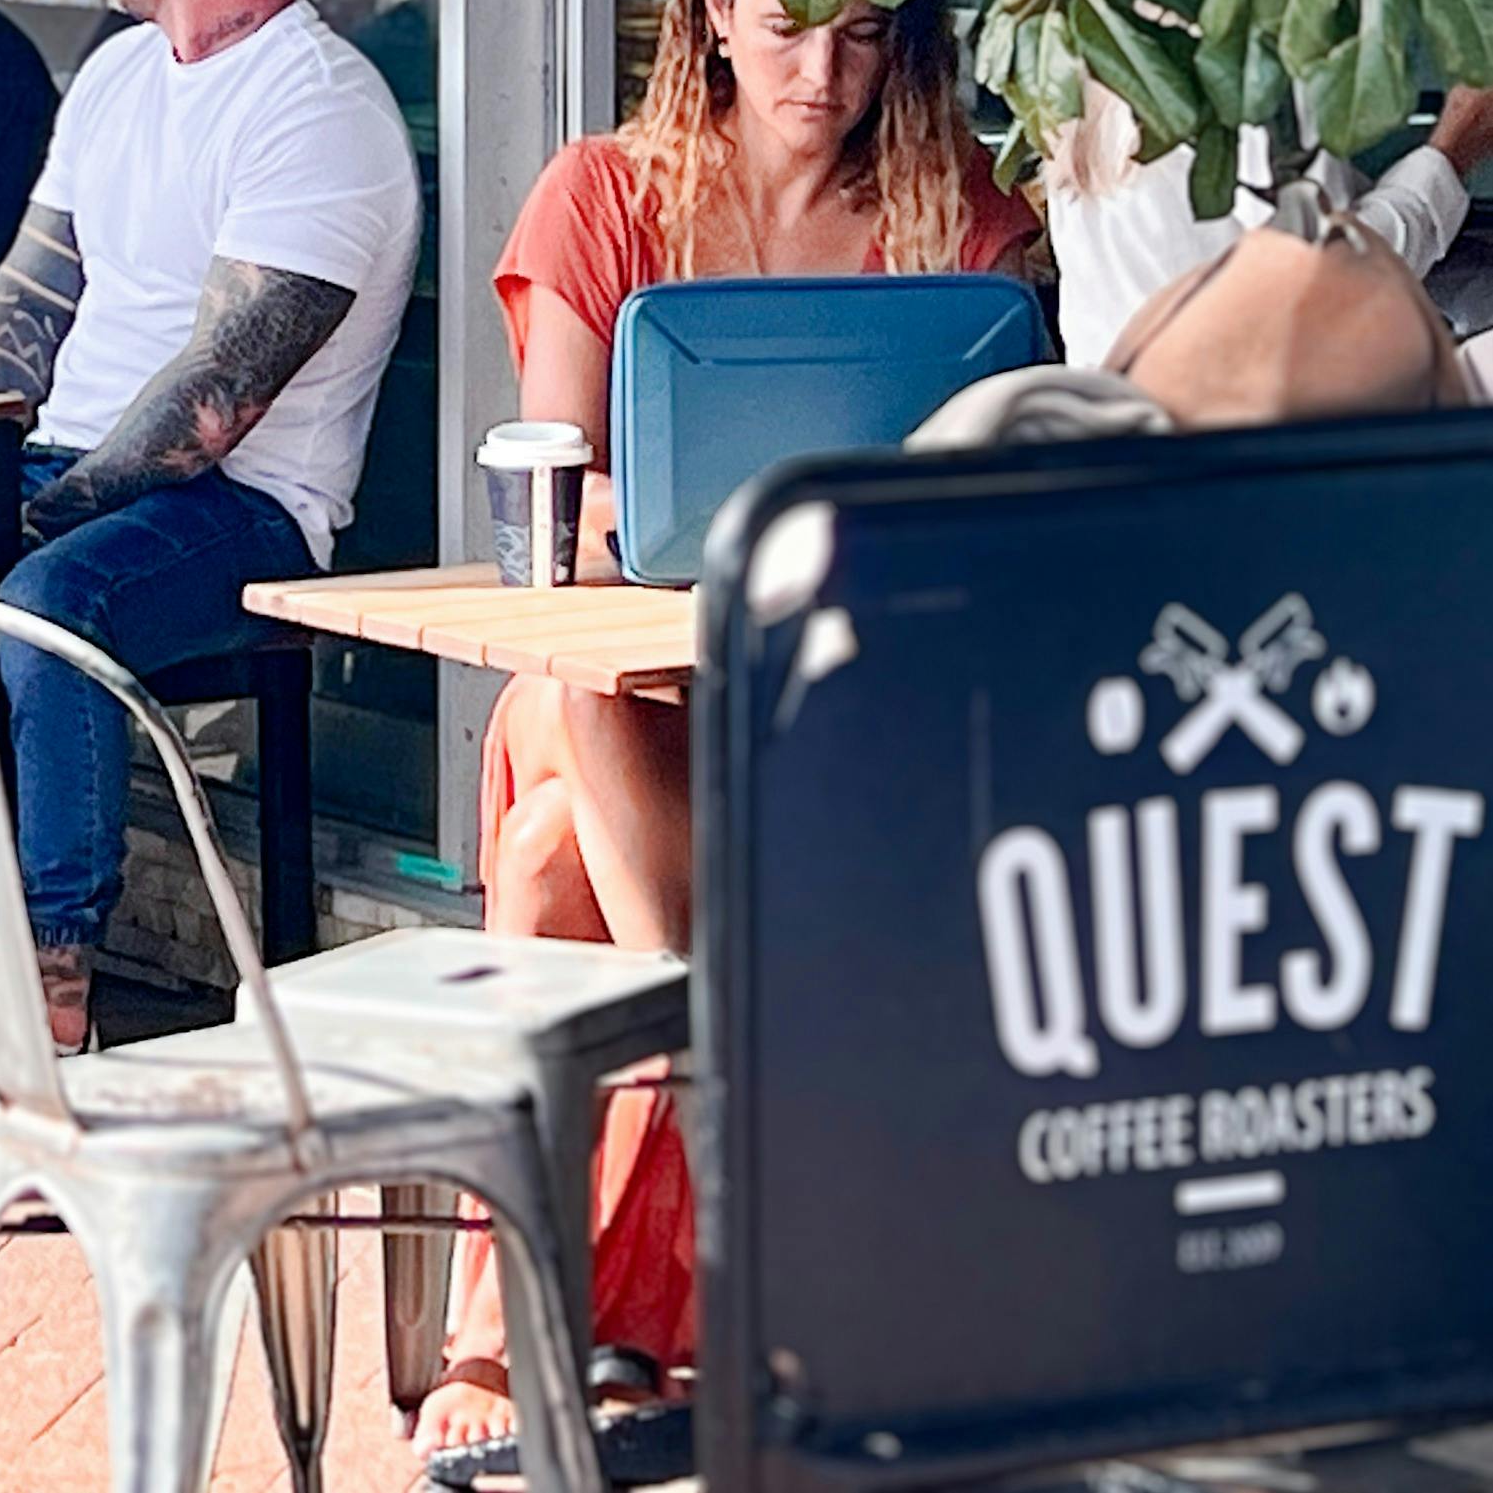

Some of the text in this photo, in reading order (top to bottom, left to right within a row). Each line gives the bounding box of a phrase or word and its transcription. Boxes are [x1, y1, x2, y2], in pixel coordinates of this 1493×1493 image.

[977, 779, 1484, 1079] QUEST
[1018, 1065, 1436, 1184] COFFEE ROASTERS
